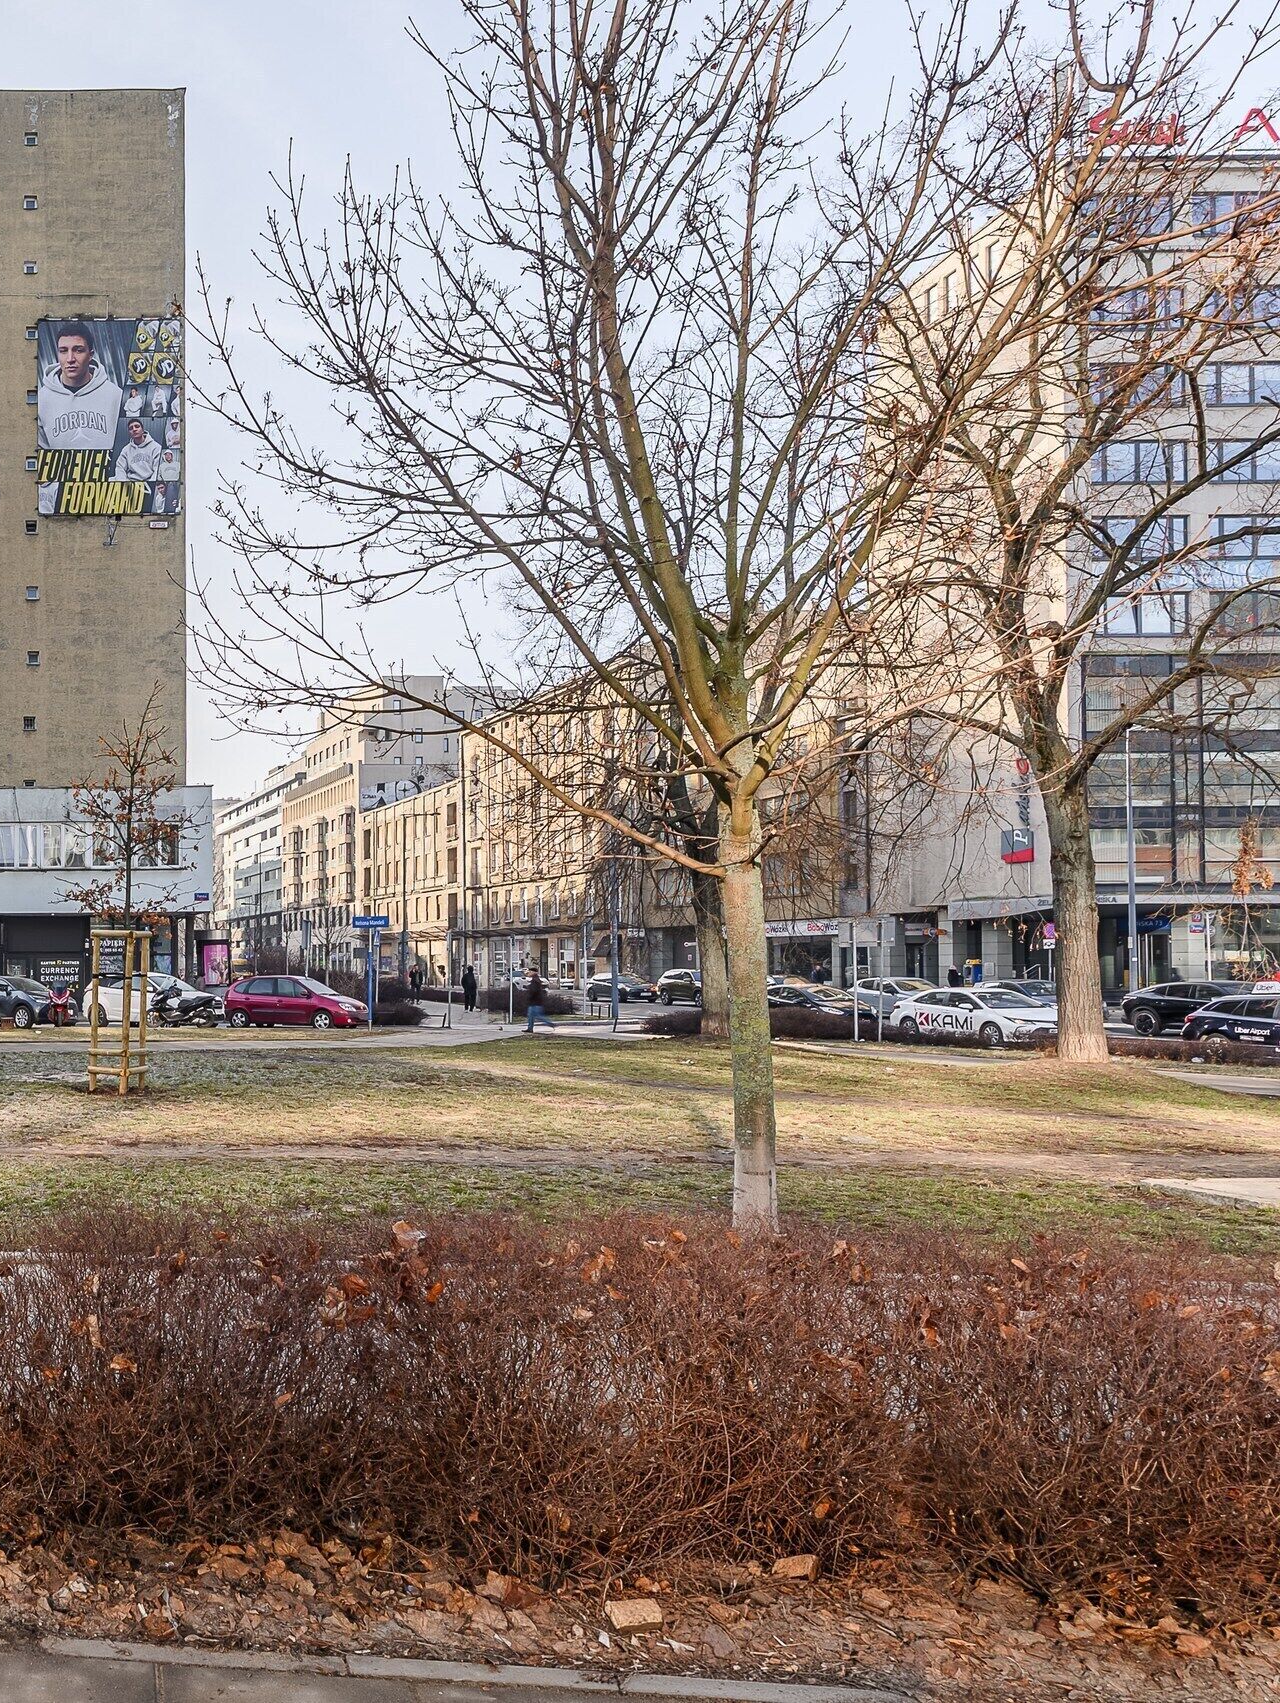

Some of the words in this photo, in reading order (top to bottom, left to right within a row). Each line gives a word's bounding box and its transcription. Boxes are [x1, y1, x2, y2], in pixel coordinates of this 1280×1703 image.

[52, 411, 107, 437] JORDAN
[1234, 1026, 1251, 1034] Uber
[1250, 1027, 1271, 1036] Airport
